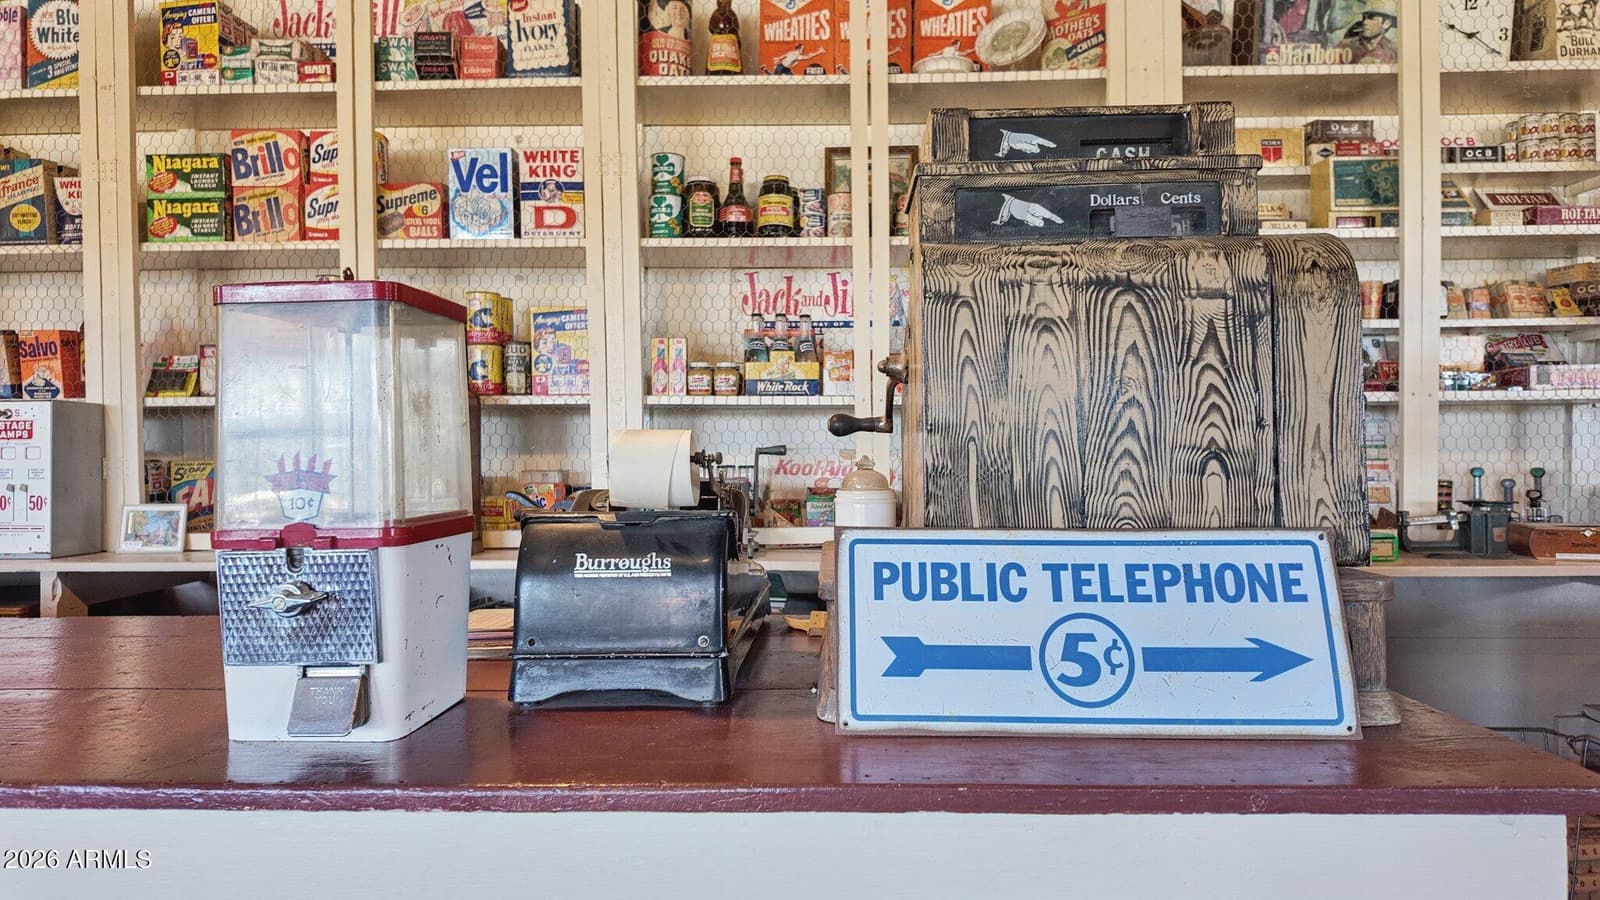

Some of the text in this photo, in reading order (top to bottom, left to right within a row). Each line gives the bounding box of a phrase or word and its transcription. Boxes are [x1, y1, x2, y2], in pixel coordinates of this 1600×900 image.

[188, 6, 216, 16] CAMERA
[522, 11, 557, 23] Instant
[191, 15, 214, 24] OFFER!
[764, 9, 831, 41] WHEATIES
[920, 6, 988, 37] WHEATIES
[37, 27, 79, 43] White
[516, 20, 559, 42] Ivory
[1499, 28, 1509, 41] 3
[1280, 43, 1353, 65] Marlboro
[47, 65, 53, 79] 3
[232, 141, 300, 180] Brillo
[523, 150, 580, 163] WHITE
[1466, 149, 1492, 157] OCB
[152, 155, 219, 173] Niagara
[529, 165, 577, 178] KING
[451, 152, 509, 194] Vel
[0, 176, 39, 198] France
[377, 189, 437, 214] Supreme
[1090, 192, 1201, 206] Dollars Cents
[1496, 193, 1550, 205] ROI-TAN
[153, 200, 219, 218] Niagara
[234, 197, 298, 237] Brillo
[421, 206, 428, 215] 6
[534, 205, 577, 230] D
[409, 226, 438, 237] BALLS
[742, 271, 801, 316] Jack
[801, 290, 823, 307] and
[20, 335, 58, 359] Salvo
[757, 380, 809, 395] White Rock
[29, 495, 48, 511] 50¢
[288, 496, 315, 510] 10¢
[574, 552, 672, 572] Burroughs
[873, 561, 1309, 603] PUBLIC TELEPHONE
[1057, 632, 1124, 688] 5¢
[309, 686, 345, 696] THANK
[313, 695, 335, 705] YOU
